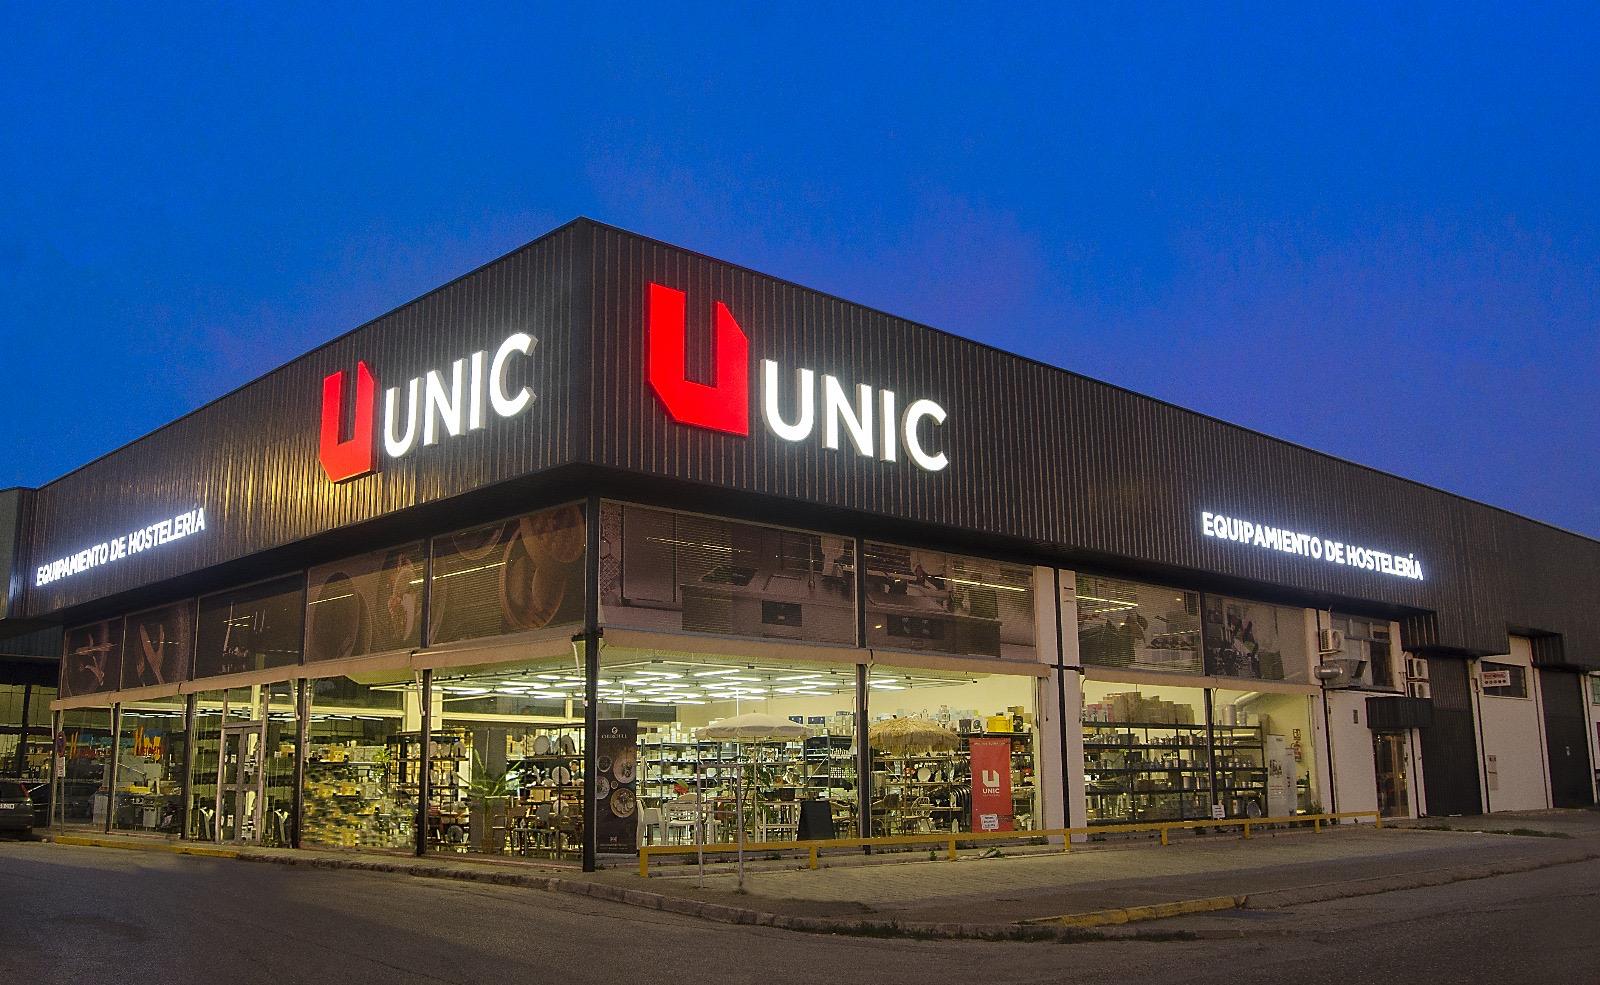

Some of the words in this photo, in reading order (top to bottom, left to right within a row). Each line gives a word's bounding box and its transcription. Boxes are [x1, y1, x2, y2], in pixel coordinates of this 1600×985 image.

[384, 332, 538, 458] UNIC
[760, 358, 949, 472] UNIC
[36, 543, 108, 586] EQUIPAMIENTO
[110, 536, 127, 561] DE
[1202, 511, 1322, 559] EQUIPAMIENTO
[1325, 539, 1345, 564] DE
[1347, 545, 1424, 580] HOSTELERÍA
